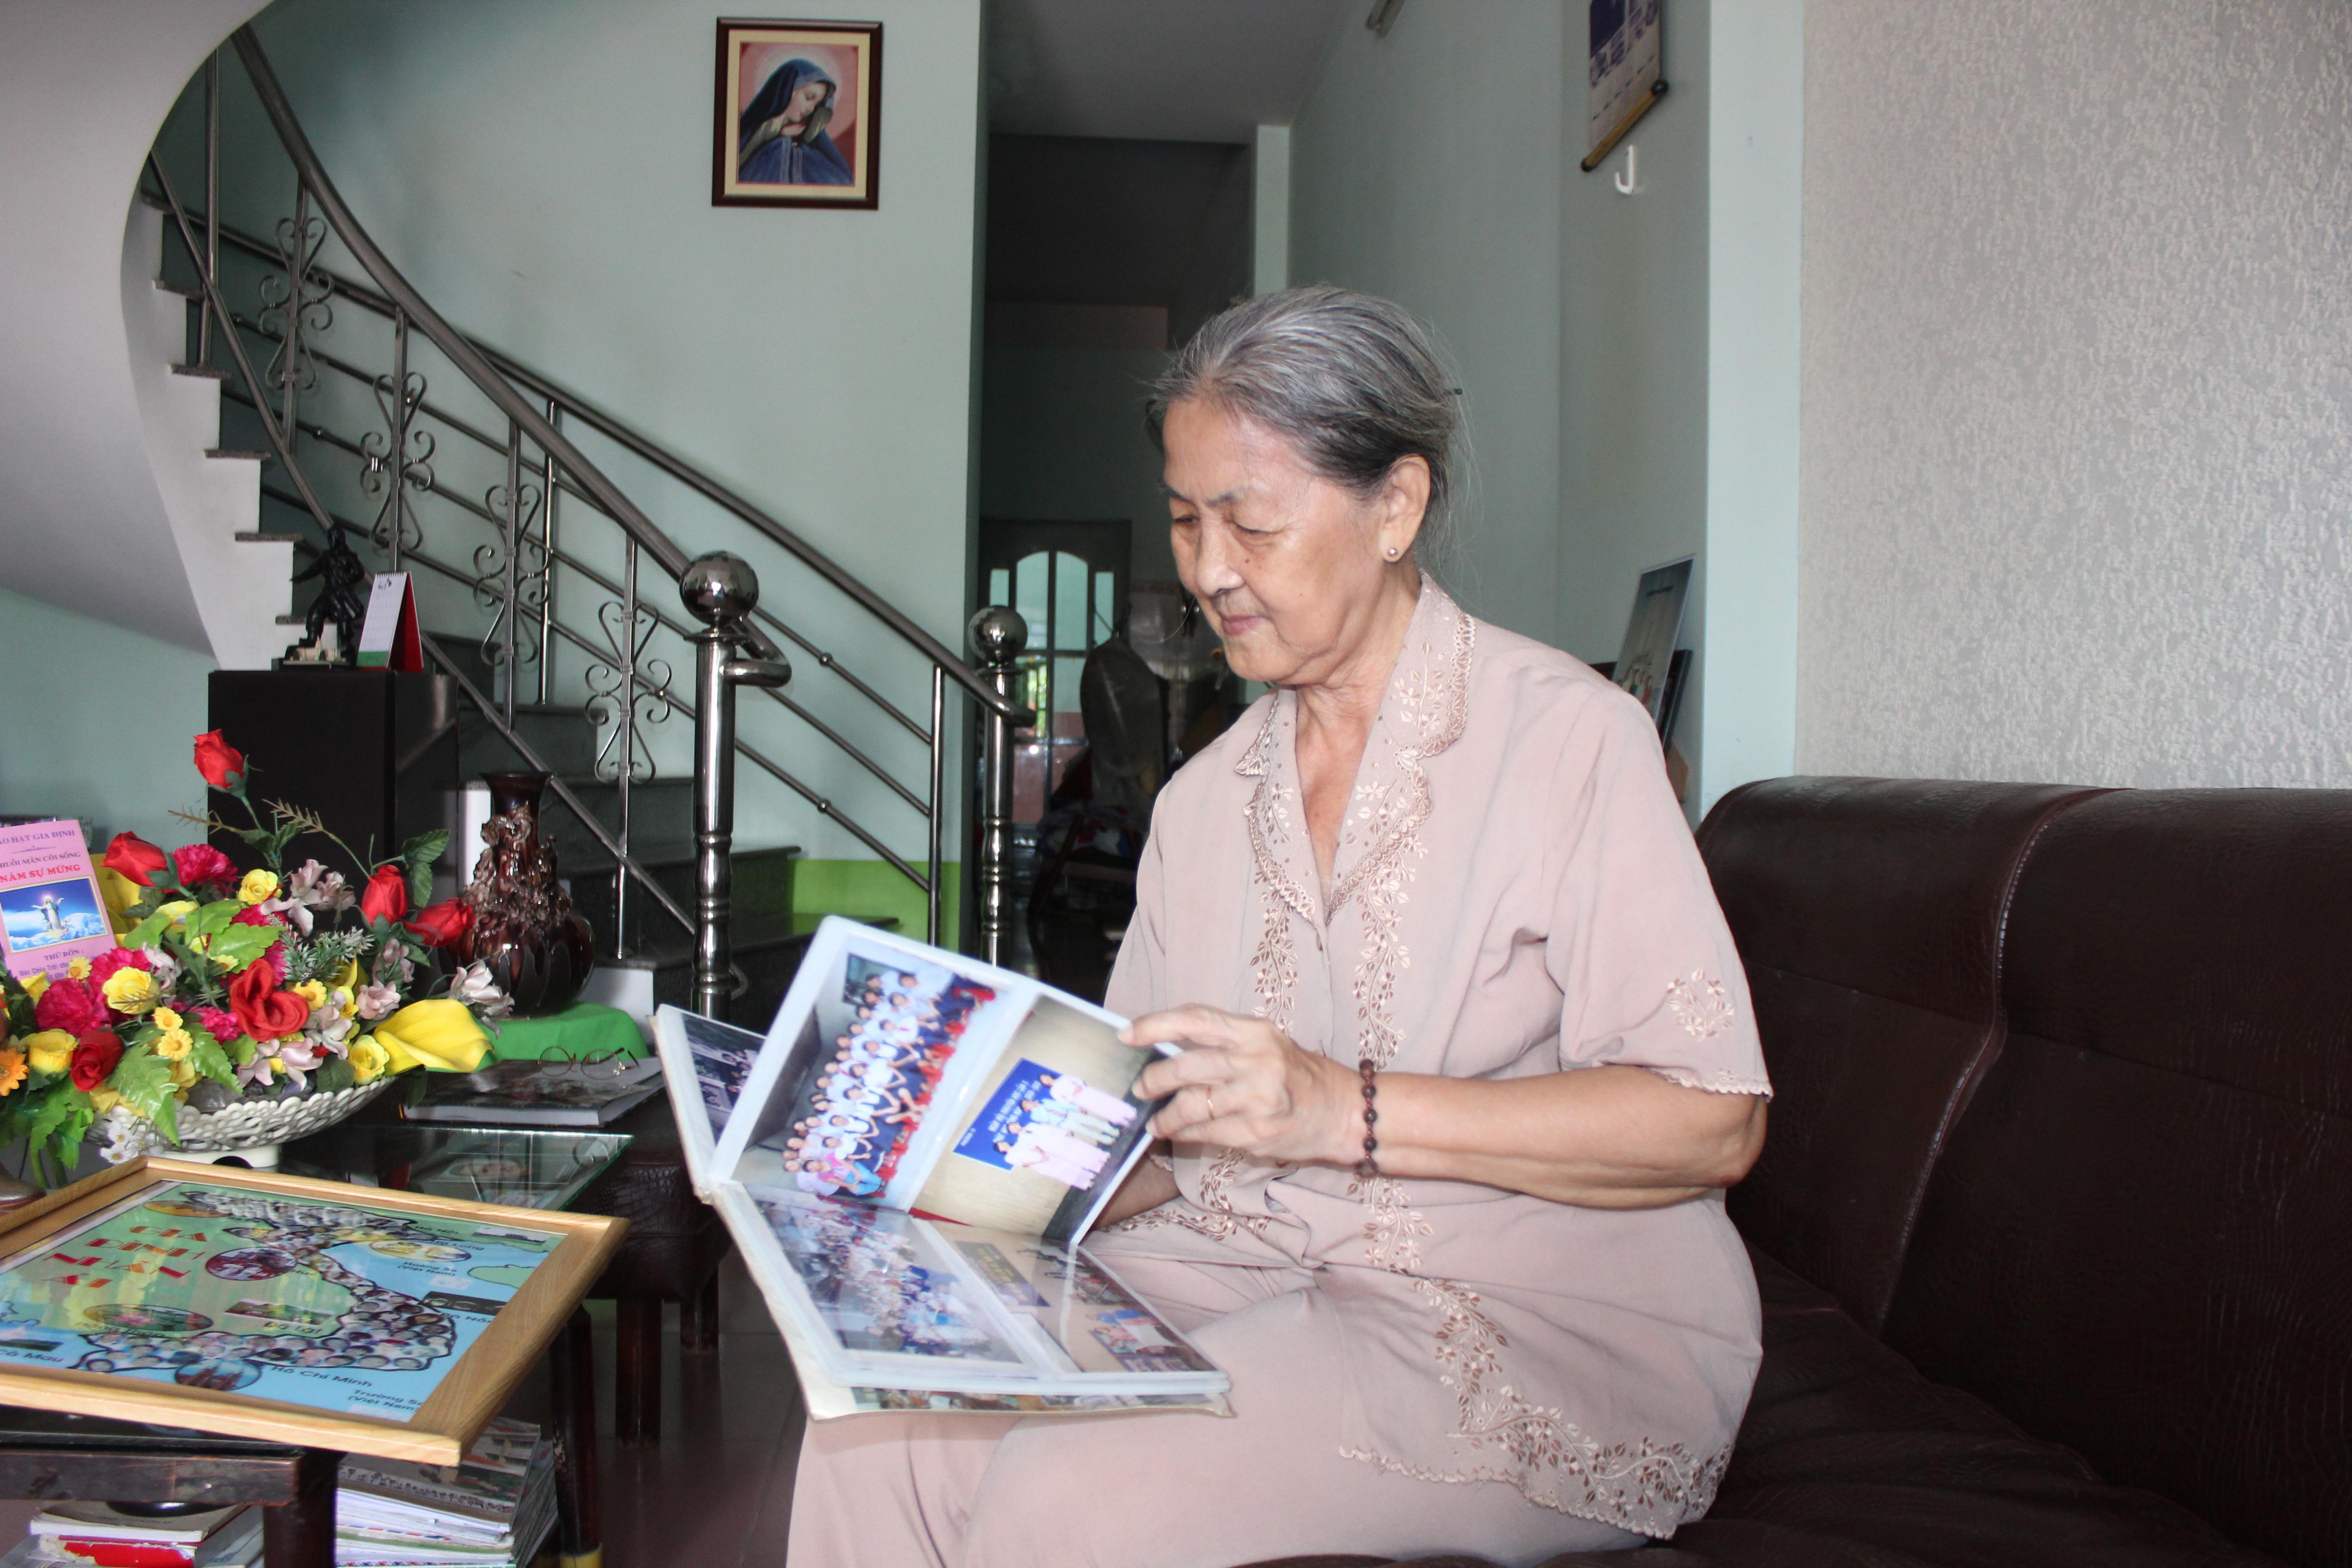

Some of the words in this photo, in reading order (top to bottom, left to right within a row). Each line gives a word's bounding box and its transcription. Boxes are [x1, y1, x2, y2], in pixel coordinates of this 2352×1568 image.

[11, 835, 31, 843] HẠT
[29, 868, 44, 878] SỰ
[129, 1225, 208, 1242] GIA
[333, 1376, 372, 1387] Minh
